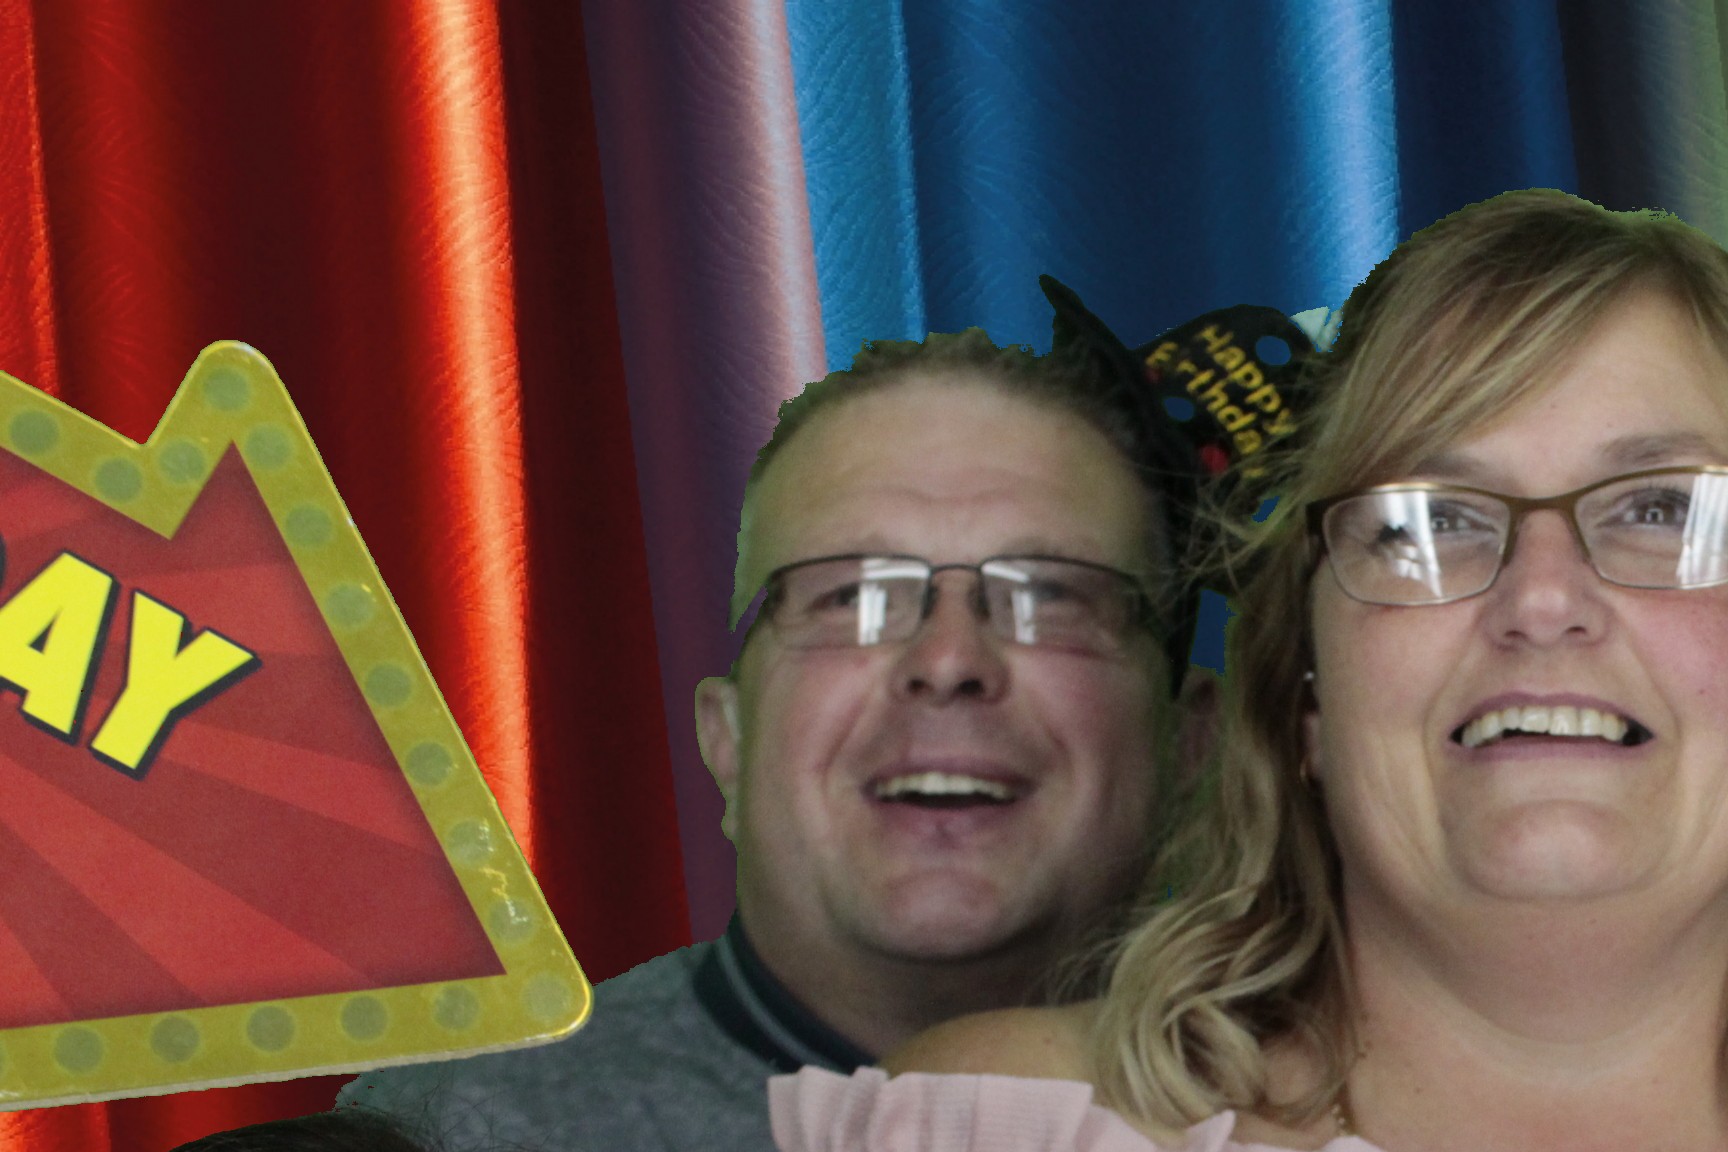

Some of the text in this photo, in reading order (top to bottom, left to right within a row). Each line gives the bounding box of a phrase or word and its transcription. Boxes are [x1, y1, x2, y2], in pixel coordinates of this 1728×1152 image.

[1145, 341, 1266, 480] Brthda
[1196, 324, 1298, 435] Happy
[0, 545, 260, 778] AY
